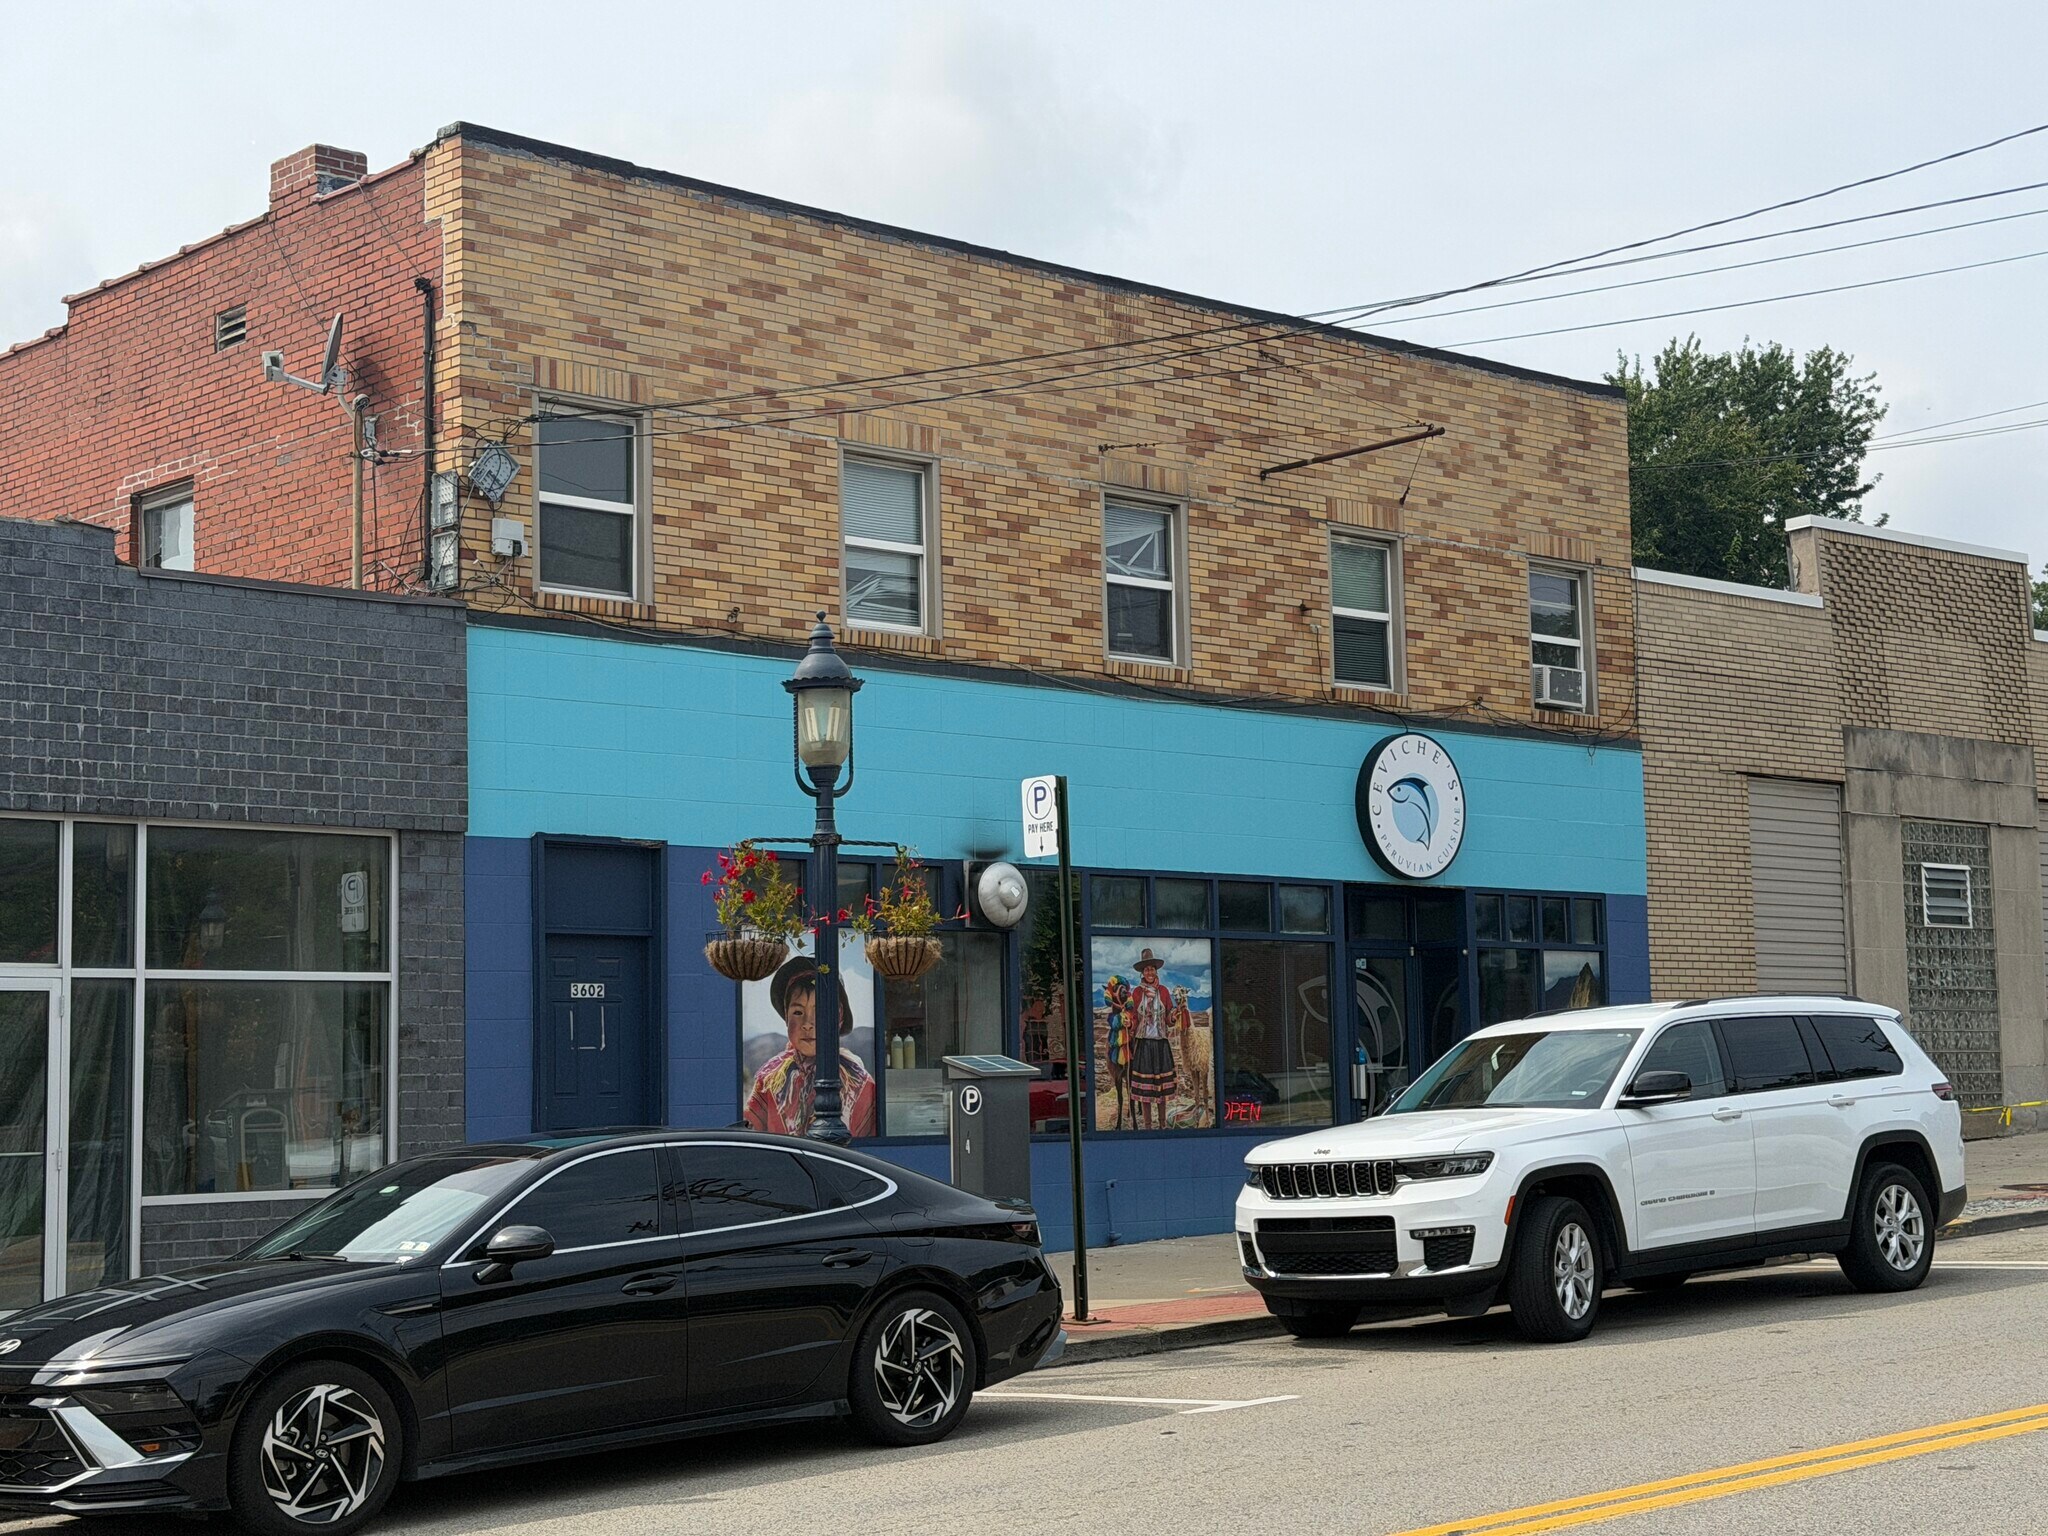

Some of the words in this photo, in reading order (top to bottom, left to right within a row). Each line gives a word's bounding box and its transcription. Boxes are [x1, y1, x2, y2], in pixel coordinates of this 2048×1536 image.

[1372, 740, 1458, 816] CEVICHE'S
[1034, 786, 1047, 814] P
[1028, 823, 1038, 834] PAY
[1040, 821, 1054, 833] HERE
[1380, 834, 1432, 872] PERUVIAN
[1438, 807, 1461, 864] CUISINE
[572, 984, 604, 997] 3602
[966, 1089, 979, 1111] P
